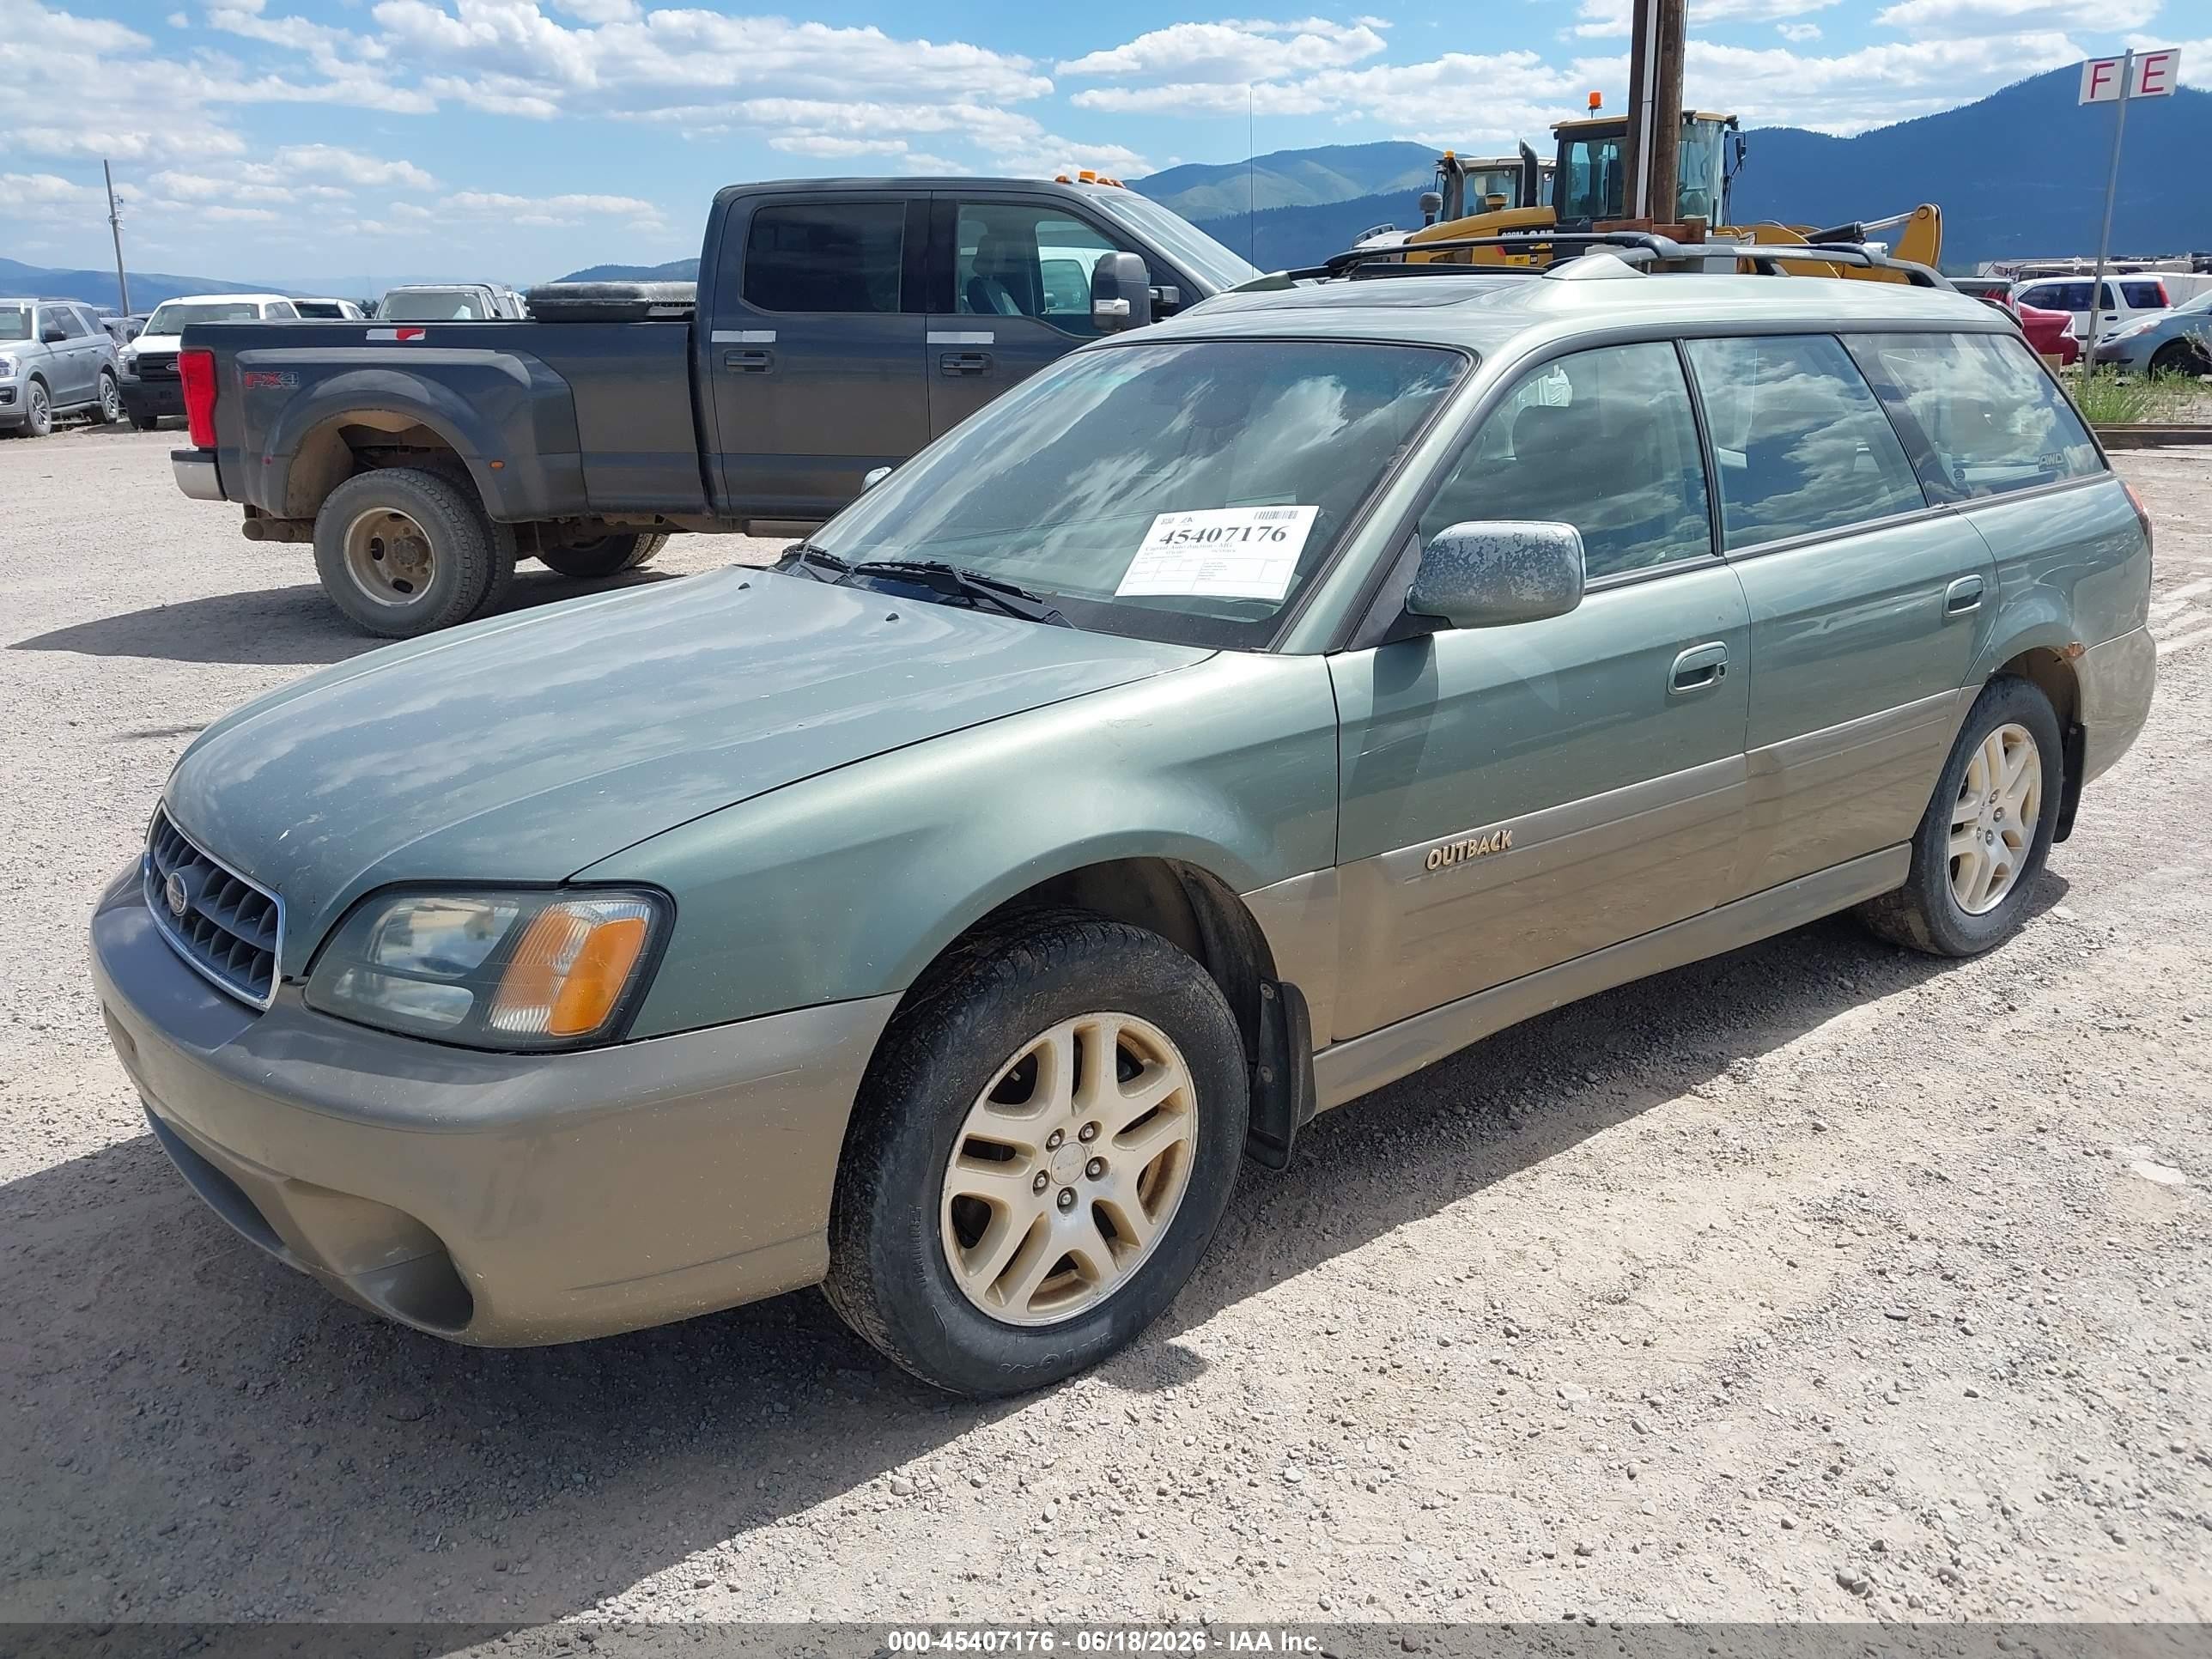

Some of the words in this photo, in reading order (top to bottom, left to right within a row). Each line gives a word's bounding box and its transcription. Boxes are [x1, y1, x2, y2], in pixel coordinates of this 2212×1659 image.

[2090, 63, 2115, 99] F
[2142, 56, 2169, 94] E
[246, 371, 299, 389] FX4
[2039, 453, 2063, 466] AWD
[1159, 526, 1290, 544] 45407176
[1425, 830, 1514, 871] OUTBACK
